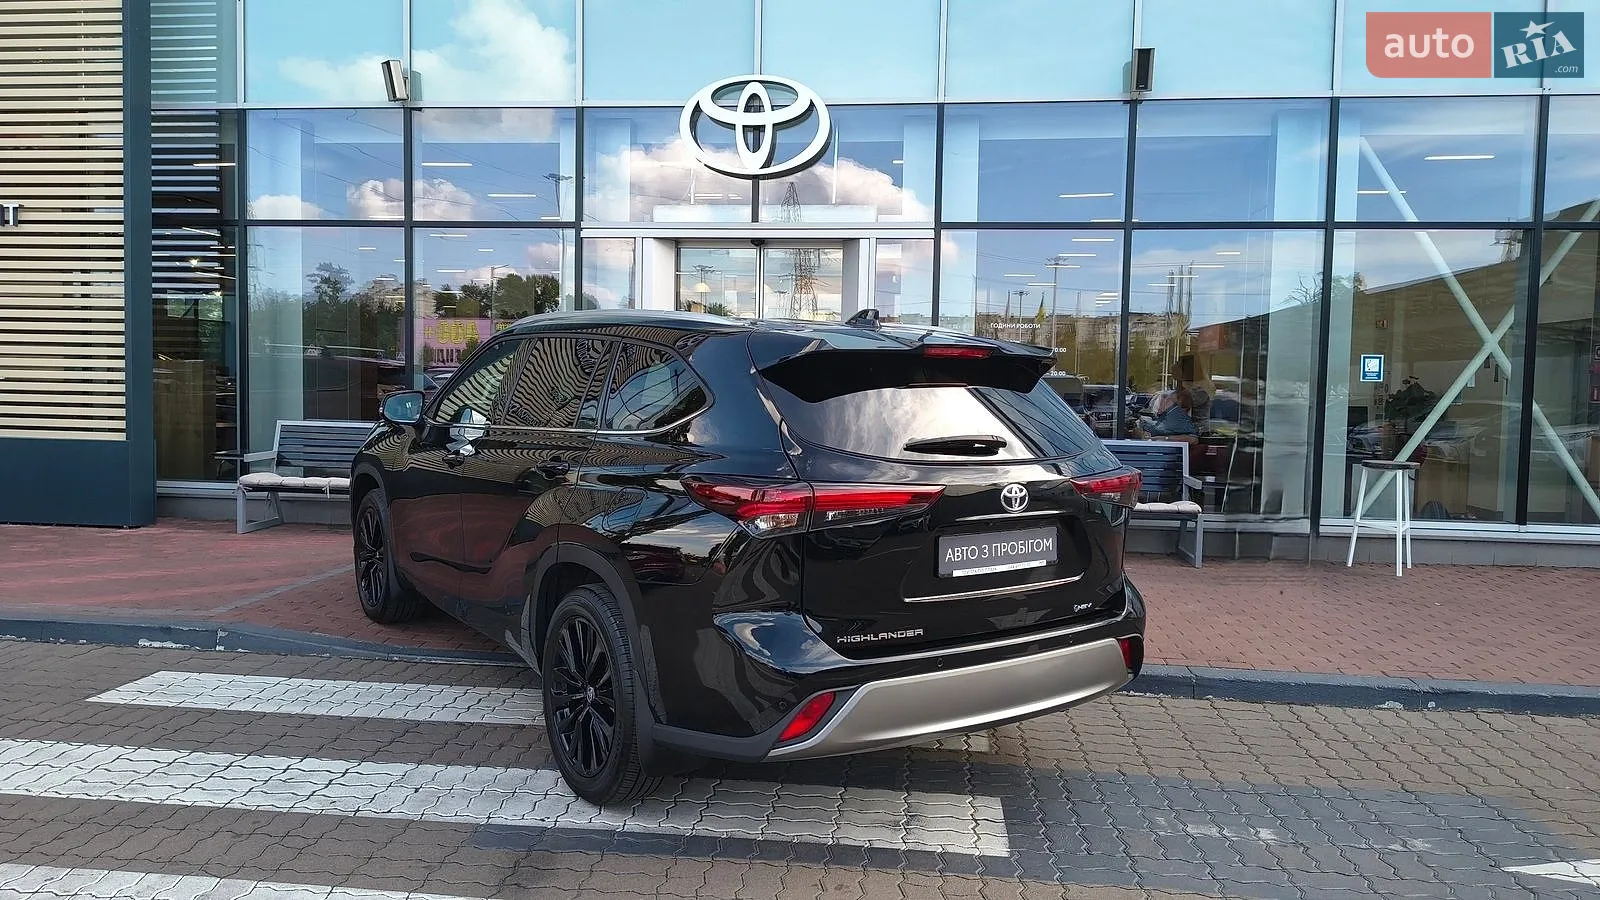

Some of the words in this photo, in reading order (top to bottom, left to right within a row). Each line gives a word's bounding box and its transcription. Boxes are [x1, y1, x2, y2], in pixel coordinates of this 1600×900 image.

[945, 545, 979, 562] АВТО
[981, 544, 989, 558] З
[992, 537, 1053, 557] ПРОБІГОМ
[836, 628, 924, 643] HIGHLANDER
